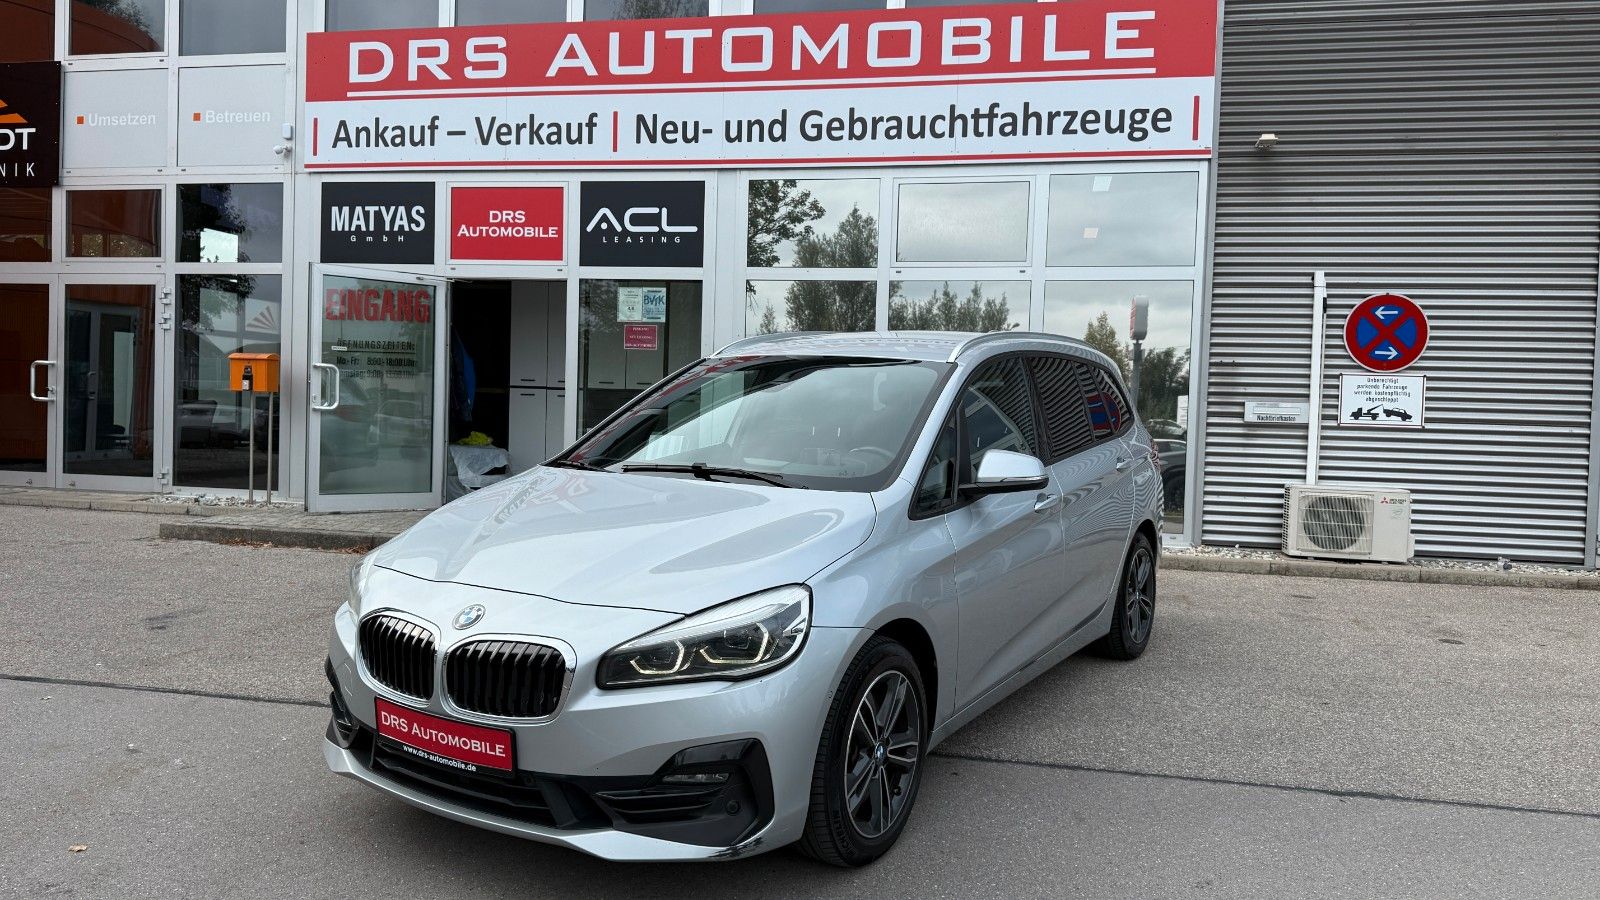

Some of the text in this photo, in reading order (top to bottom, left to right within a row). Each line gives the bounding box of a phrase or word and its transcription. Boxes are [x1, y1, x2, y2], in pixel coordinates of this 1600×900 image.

[348, 10, 1156, 84] DRS AUTOMOBILE
[88, 112, 156, 127] Umsetzen
[205, 110, 271, 124] Betreuen
[331, 115, 440, 149] Ankauf
[474, 112, 598, 147] Verkauf
[634, 112, 713, 145] Neu-
[724, 108, 788, 143] und
[799, 101, 1173, 142] Gebrauchtfahrzeuge
[330, 205, 426, 232] MATYAS
[488, 210, 526, 224] DRS
[586, 207, 698, 233] ACL
[456, 224, 558, 238] AUTOMOBILE
[325, 288, 431, 324] EINGANG
[380, 711, 506, 757] DRS AUTOMOBILE
[402, 744, 477, 772] www.drs-automobile.de
